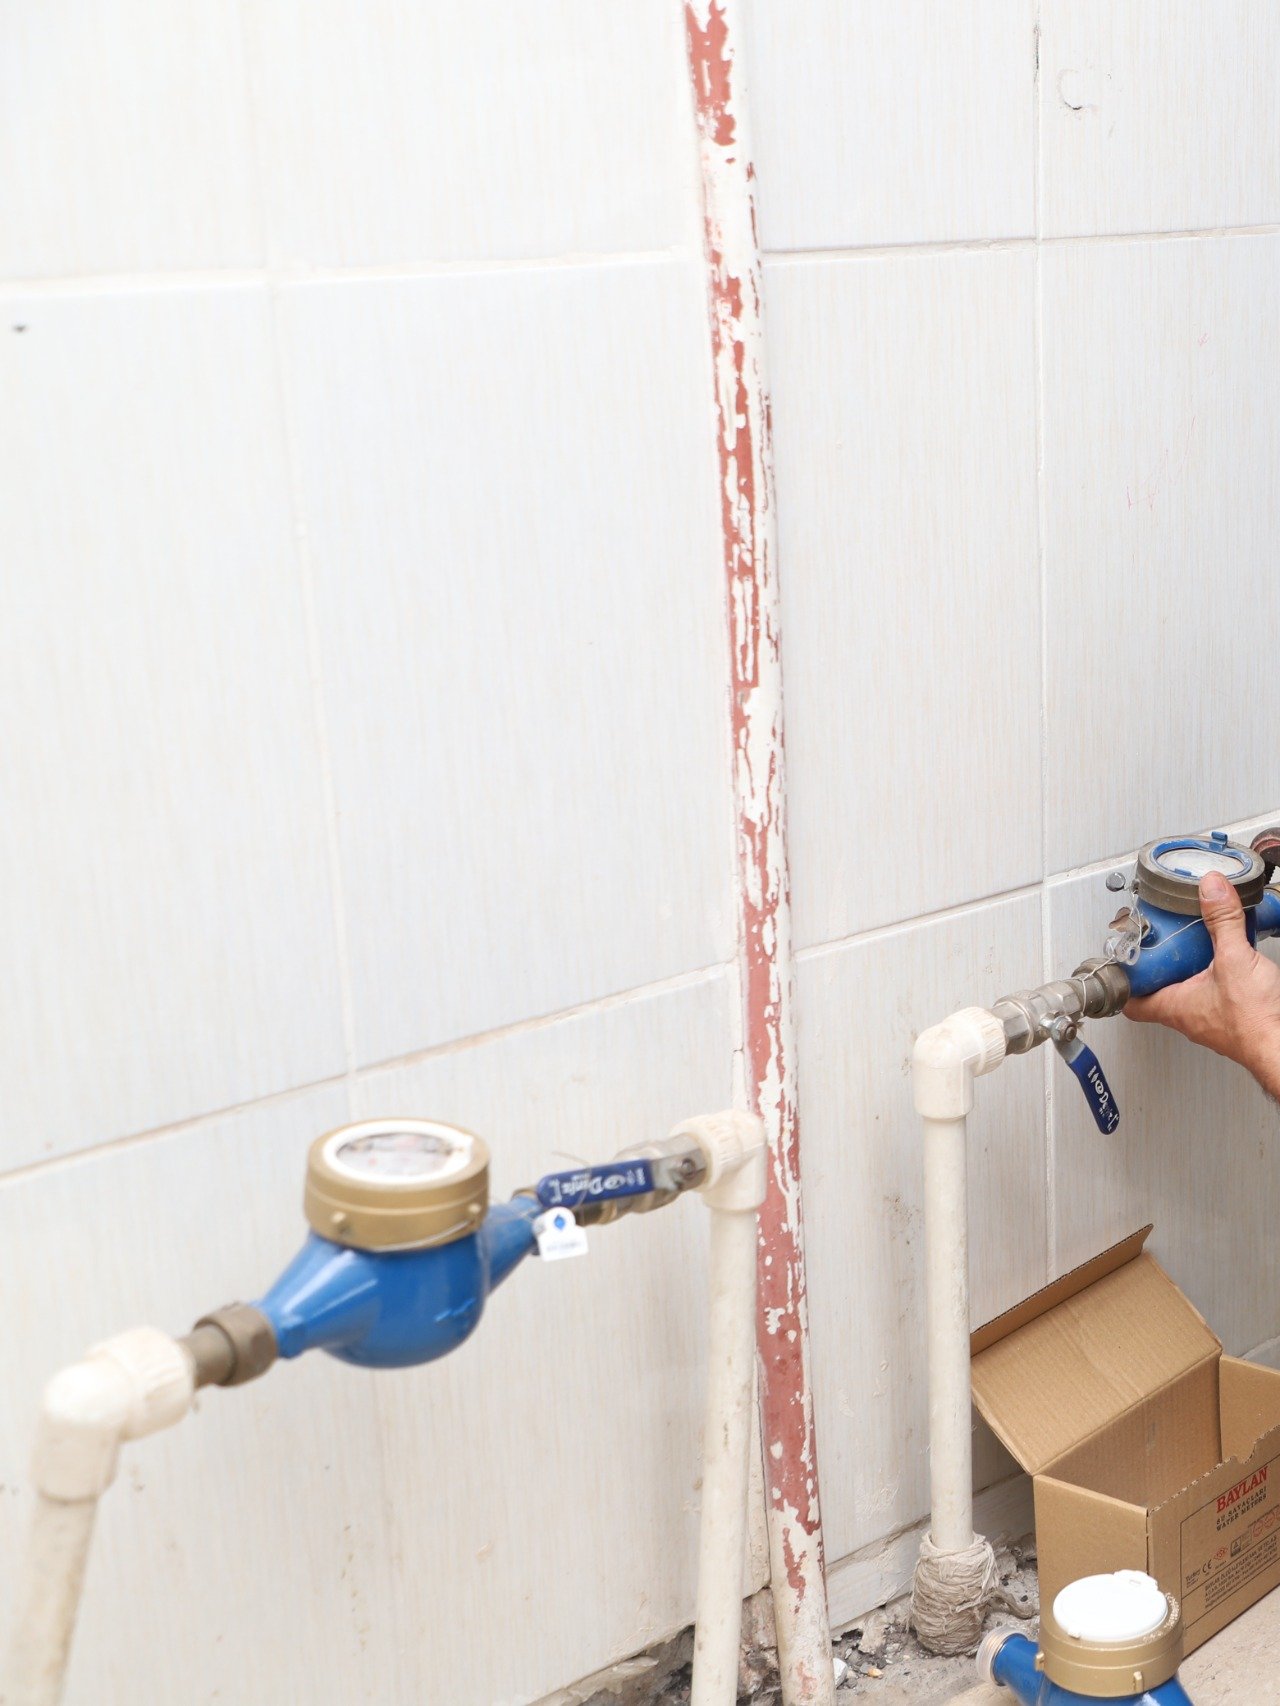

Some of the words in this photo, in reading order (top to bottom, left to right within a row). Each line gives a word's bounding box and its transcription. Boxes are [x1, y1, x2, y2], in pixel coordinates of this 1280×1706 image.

[1216, 1466, 1268, 1513] BAYLAN
[1216, 1513, 1239, 1531] WATER
[1241, 1493, 1267, 1515] METERS
